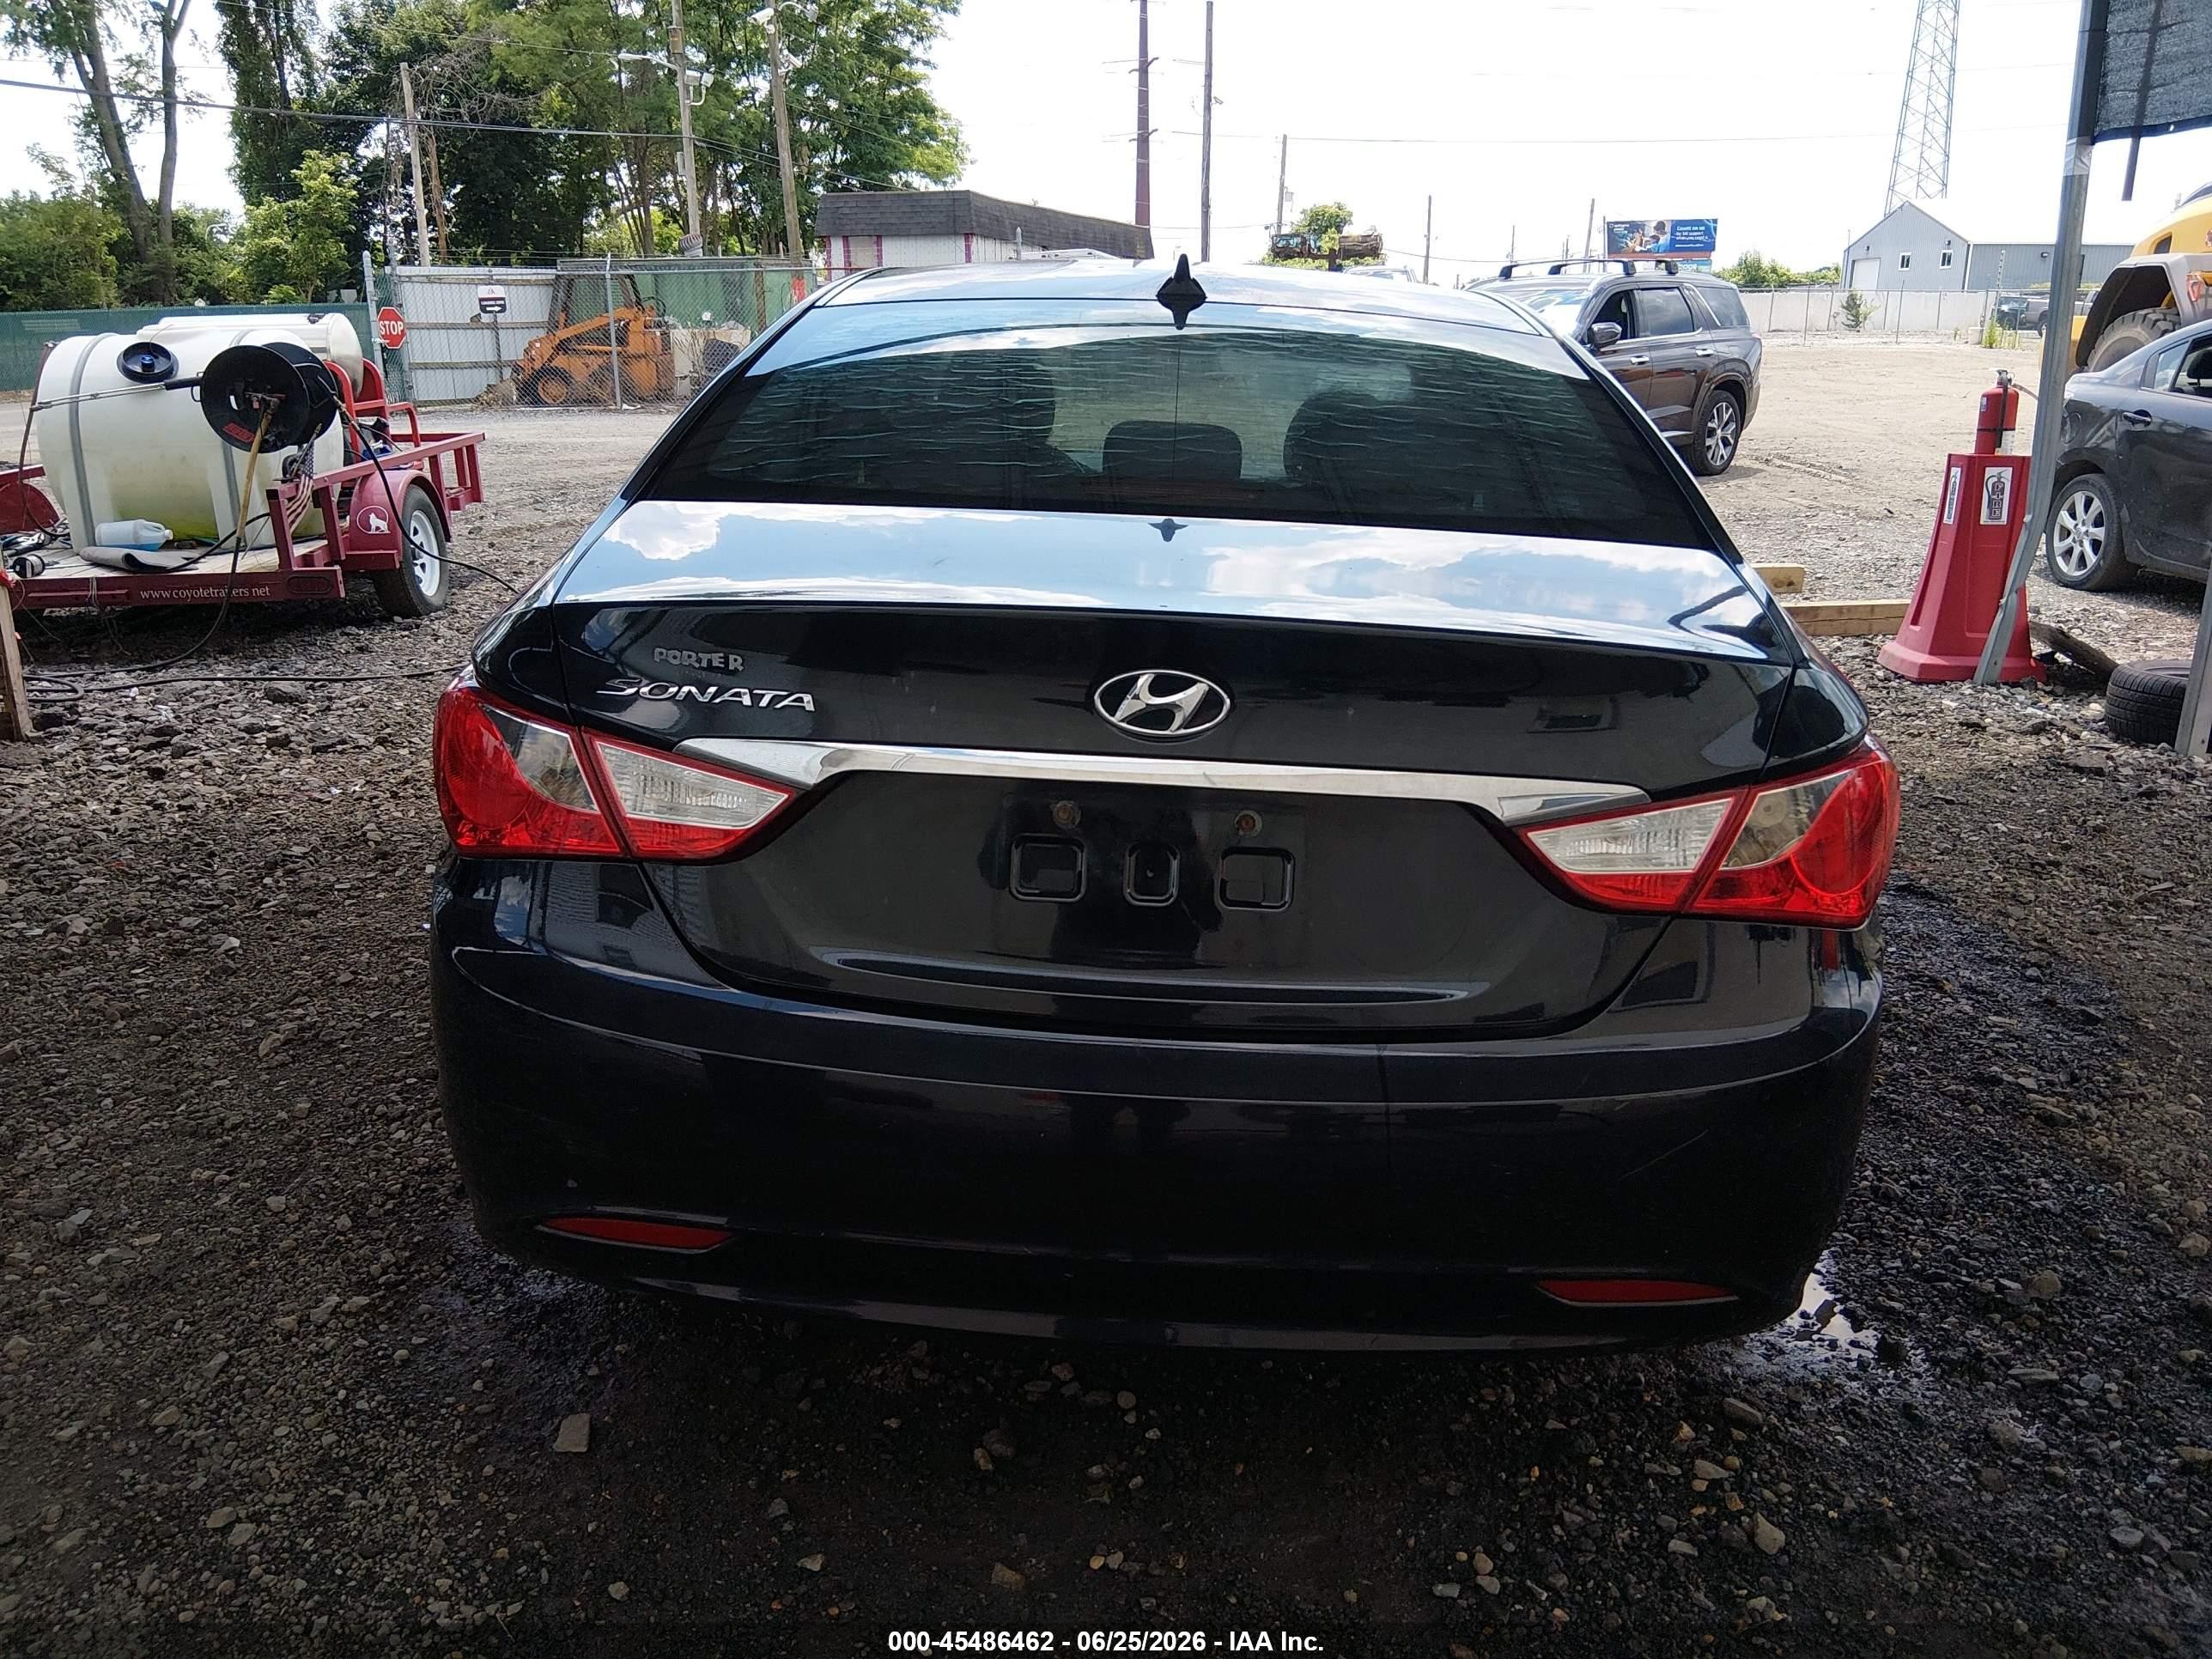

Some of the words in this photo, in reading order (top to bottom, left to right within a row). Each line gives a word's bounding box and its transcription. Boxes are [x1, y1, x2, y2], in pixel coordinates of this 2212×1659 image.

[379, 320, 404, 336] STOP
[1991, 483, 2004, 517] FIRE
[140, 586, 270, 602] wwwcoyotetraiersnet
[653, 647, 744, 672] PORTER
[596, 678, 816, 712] SONATA
